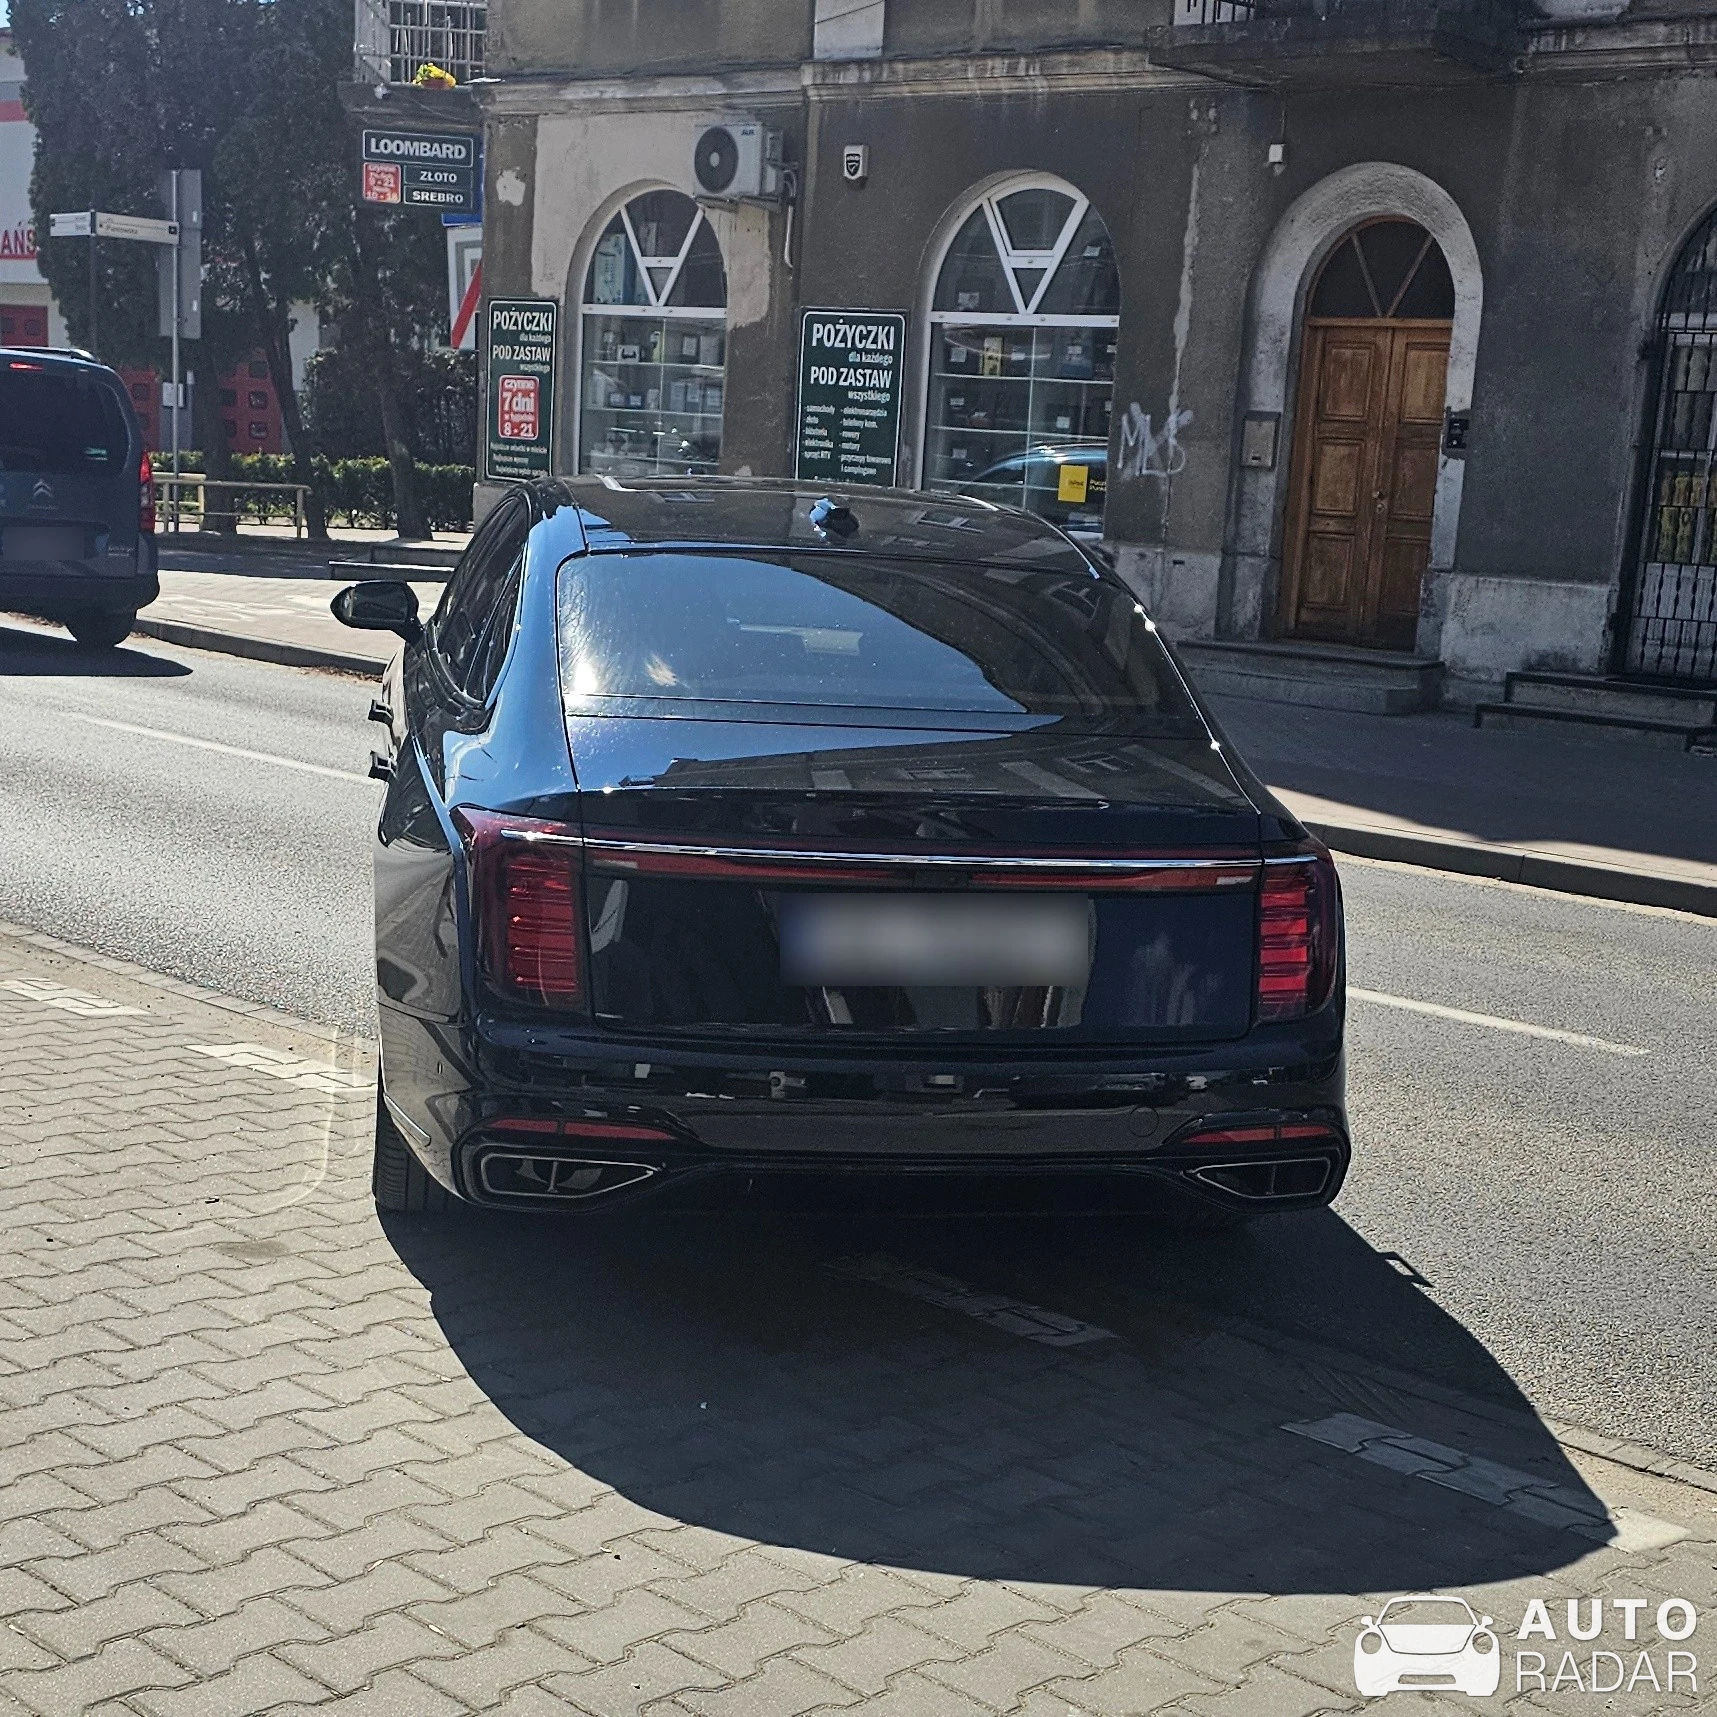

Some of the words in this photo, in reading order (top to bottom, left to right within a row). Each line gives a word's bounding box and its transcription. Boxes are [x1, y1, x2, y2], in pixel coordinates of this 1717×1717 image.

[370, 137, 467, 160] LOOMBARD
[419, 170, 458, 184] ZŁOTO
[412, 190, 464, 204] SREBRO
[493, 307, 553, 332] POŻYCZKI
[519, 332, 529, 342] dla
[811, 318, 895, 350] POŻYCZKI
[492, 344, 512, 360] POD
[513, 346, 552, 362] ZASTAW
[848, 351, 861, 363] dla
[861, 351, 894, 366] każdego
[504, 379, 536, 391] czynne
[810, 366, 838, 385] POD
[838, 367, 893, 389] ZASTAW
[502, 391, 513, 411] 7
[512, 391, 535, 412] dni
[847, 389, 891, 404] wszystkiego
[504, 421, 512, 436] 8
[520, 422, 535, 437] 21
